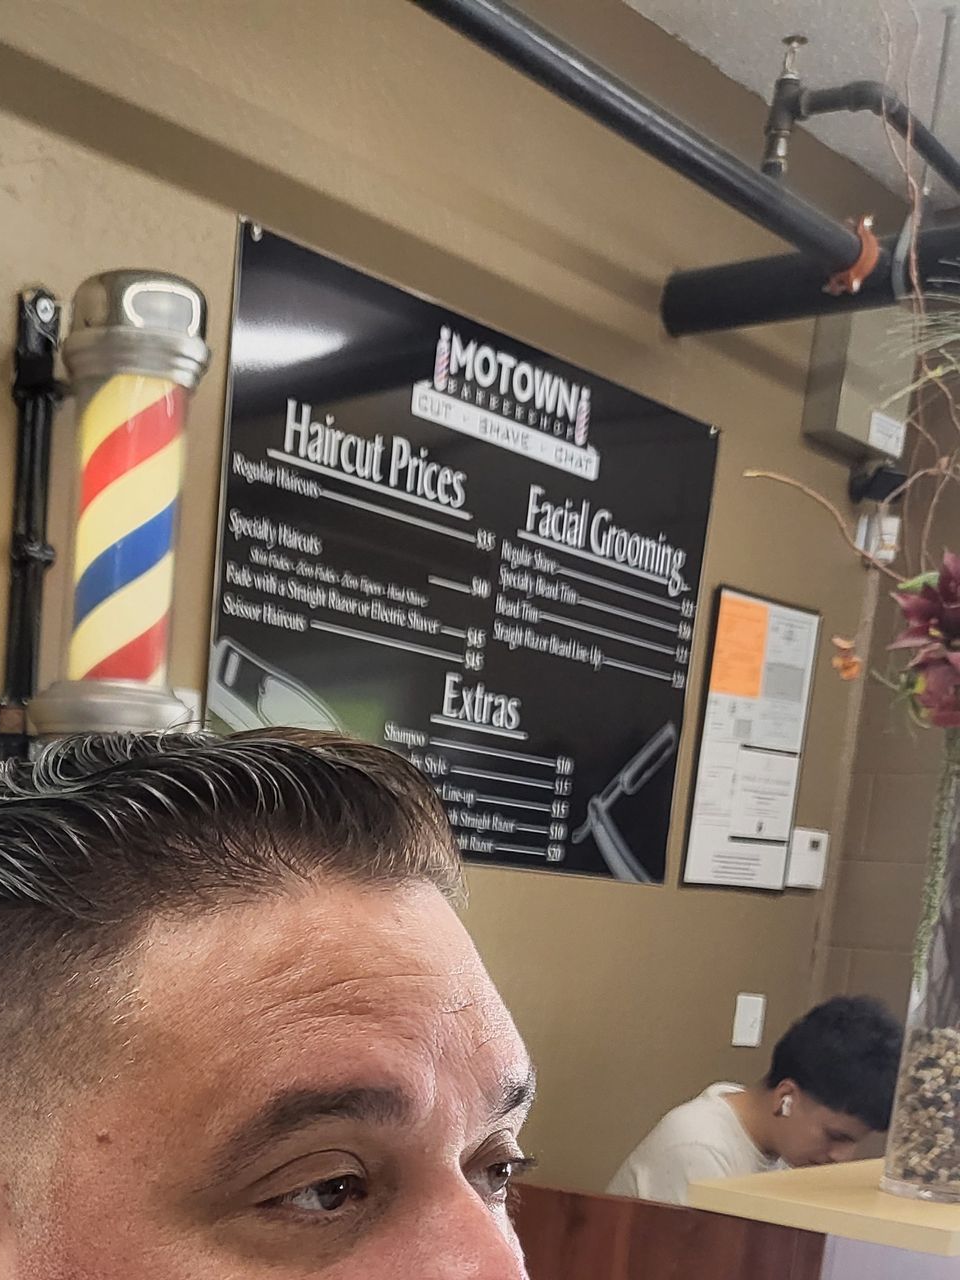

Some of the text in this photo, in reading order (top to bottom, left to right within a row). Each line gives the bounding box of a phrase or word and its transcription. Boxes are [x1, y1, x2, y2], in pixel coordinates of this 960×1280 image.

[449, 330, 581, 423] MOTOWN
[233, 451, 275, 484] Regular
[284, 397, 467, 509] Haircut Prices
[228, 507, 323, 556] Specialty Haircuts
[525, 483, 691, 598] Facial Grooming
[222, 592, 262, 622] Scissor
[263, 602, 308, 632] Haircuts
[287, 577, 328, 609] Straight
[328, 587, 357, 615] Razor
[442, 671, 522, 730] Extras
[384, 720, 428, 749] Shampoo
[423, 751, 450, 778] Style
[460, 808, 492, 834] Straight
[492, 812, 517, 834] Razor
